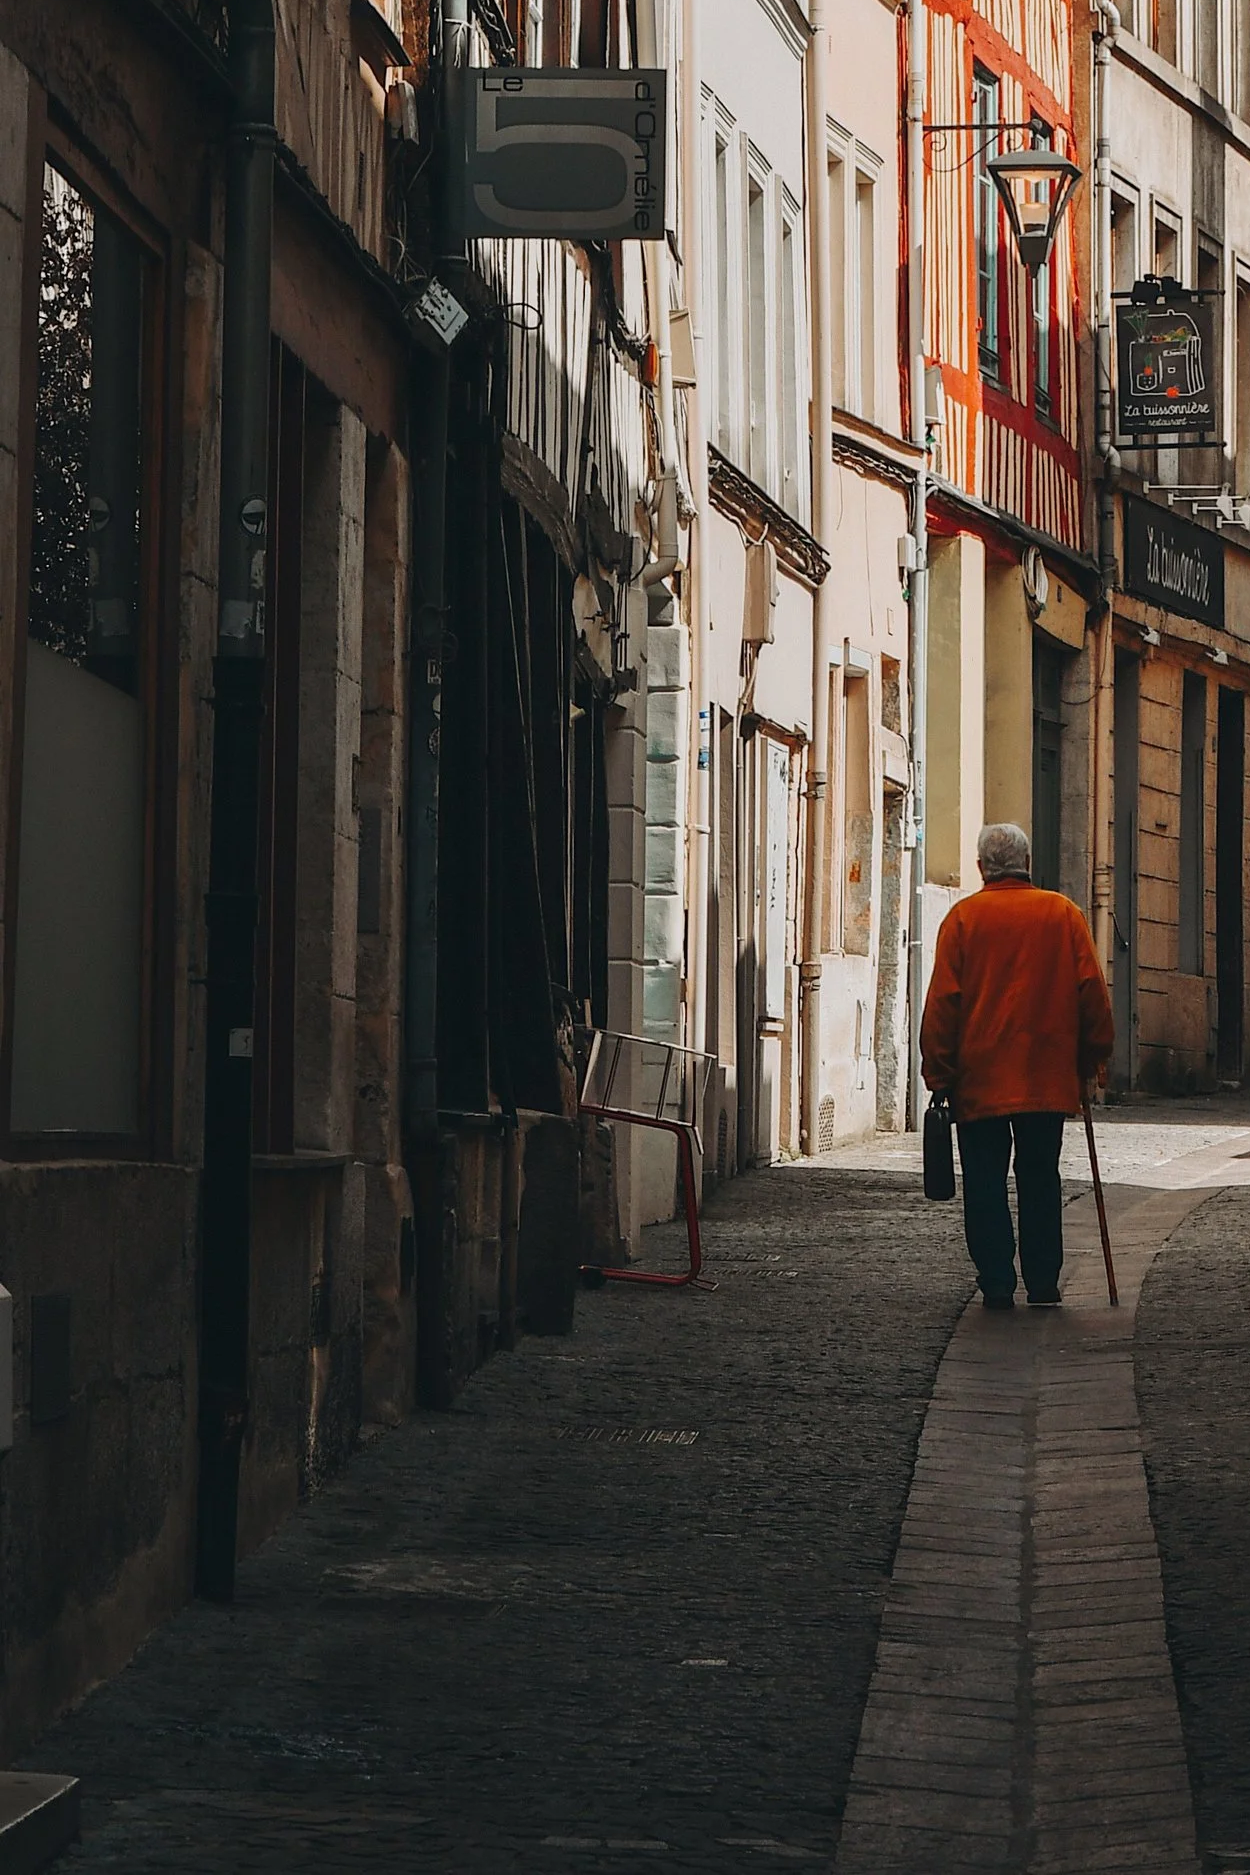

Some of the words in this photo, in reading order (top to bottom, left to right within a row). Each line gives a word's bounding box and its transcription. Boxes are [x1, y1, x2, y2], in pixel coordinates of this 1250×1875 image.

[482, 71, 523, 92] Le
[1124, 404, 1140, 417] La
[1143, 401, 1210, 416] buissonnière
[1147, 525, 1160, 583] La
